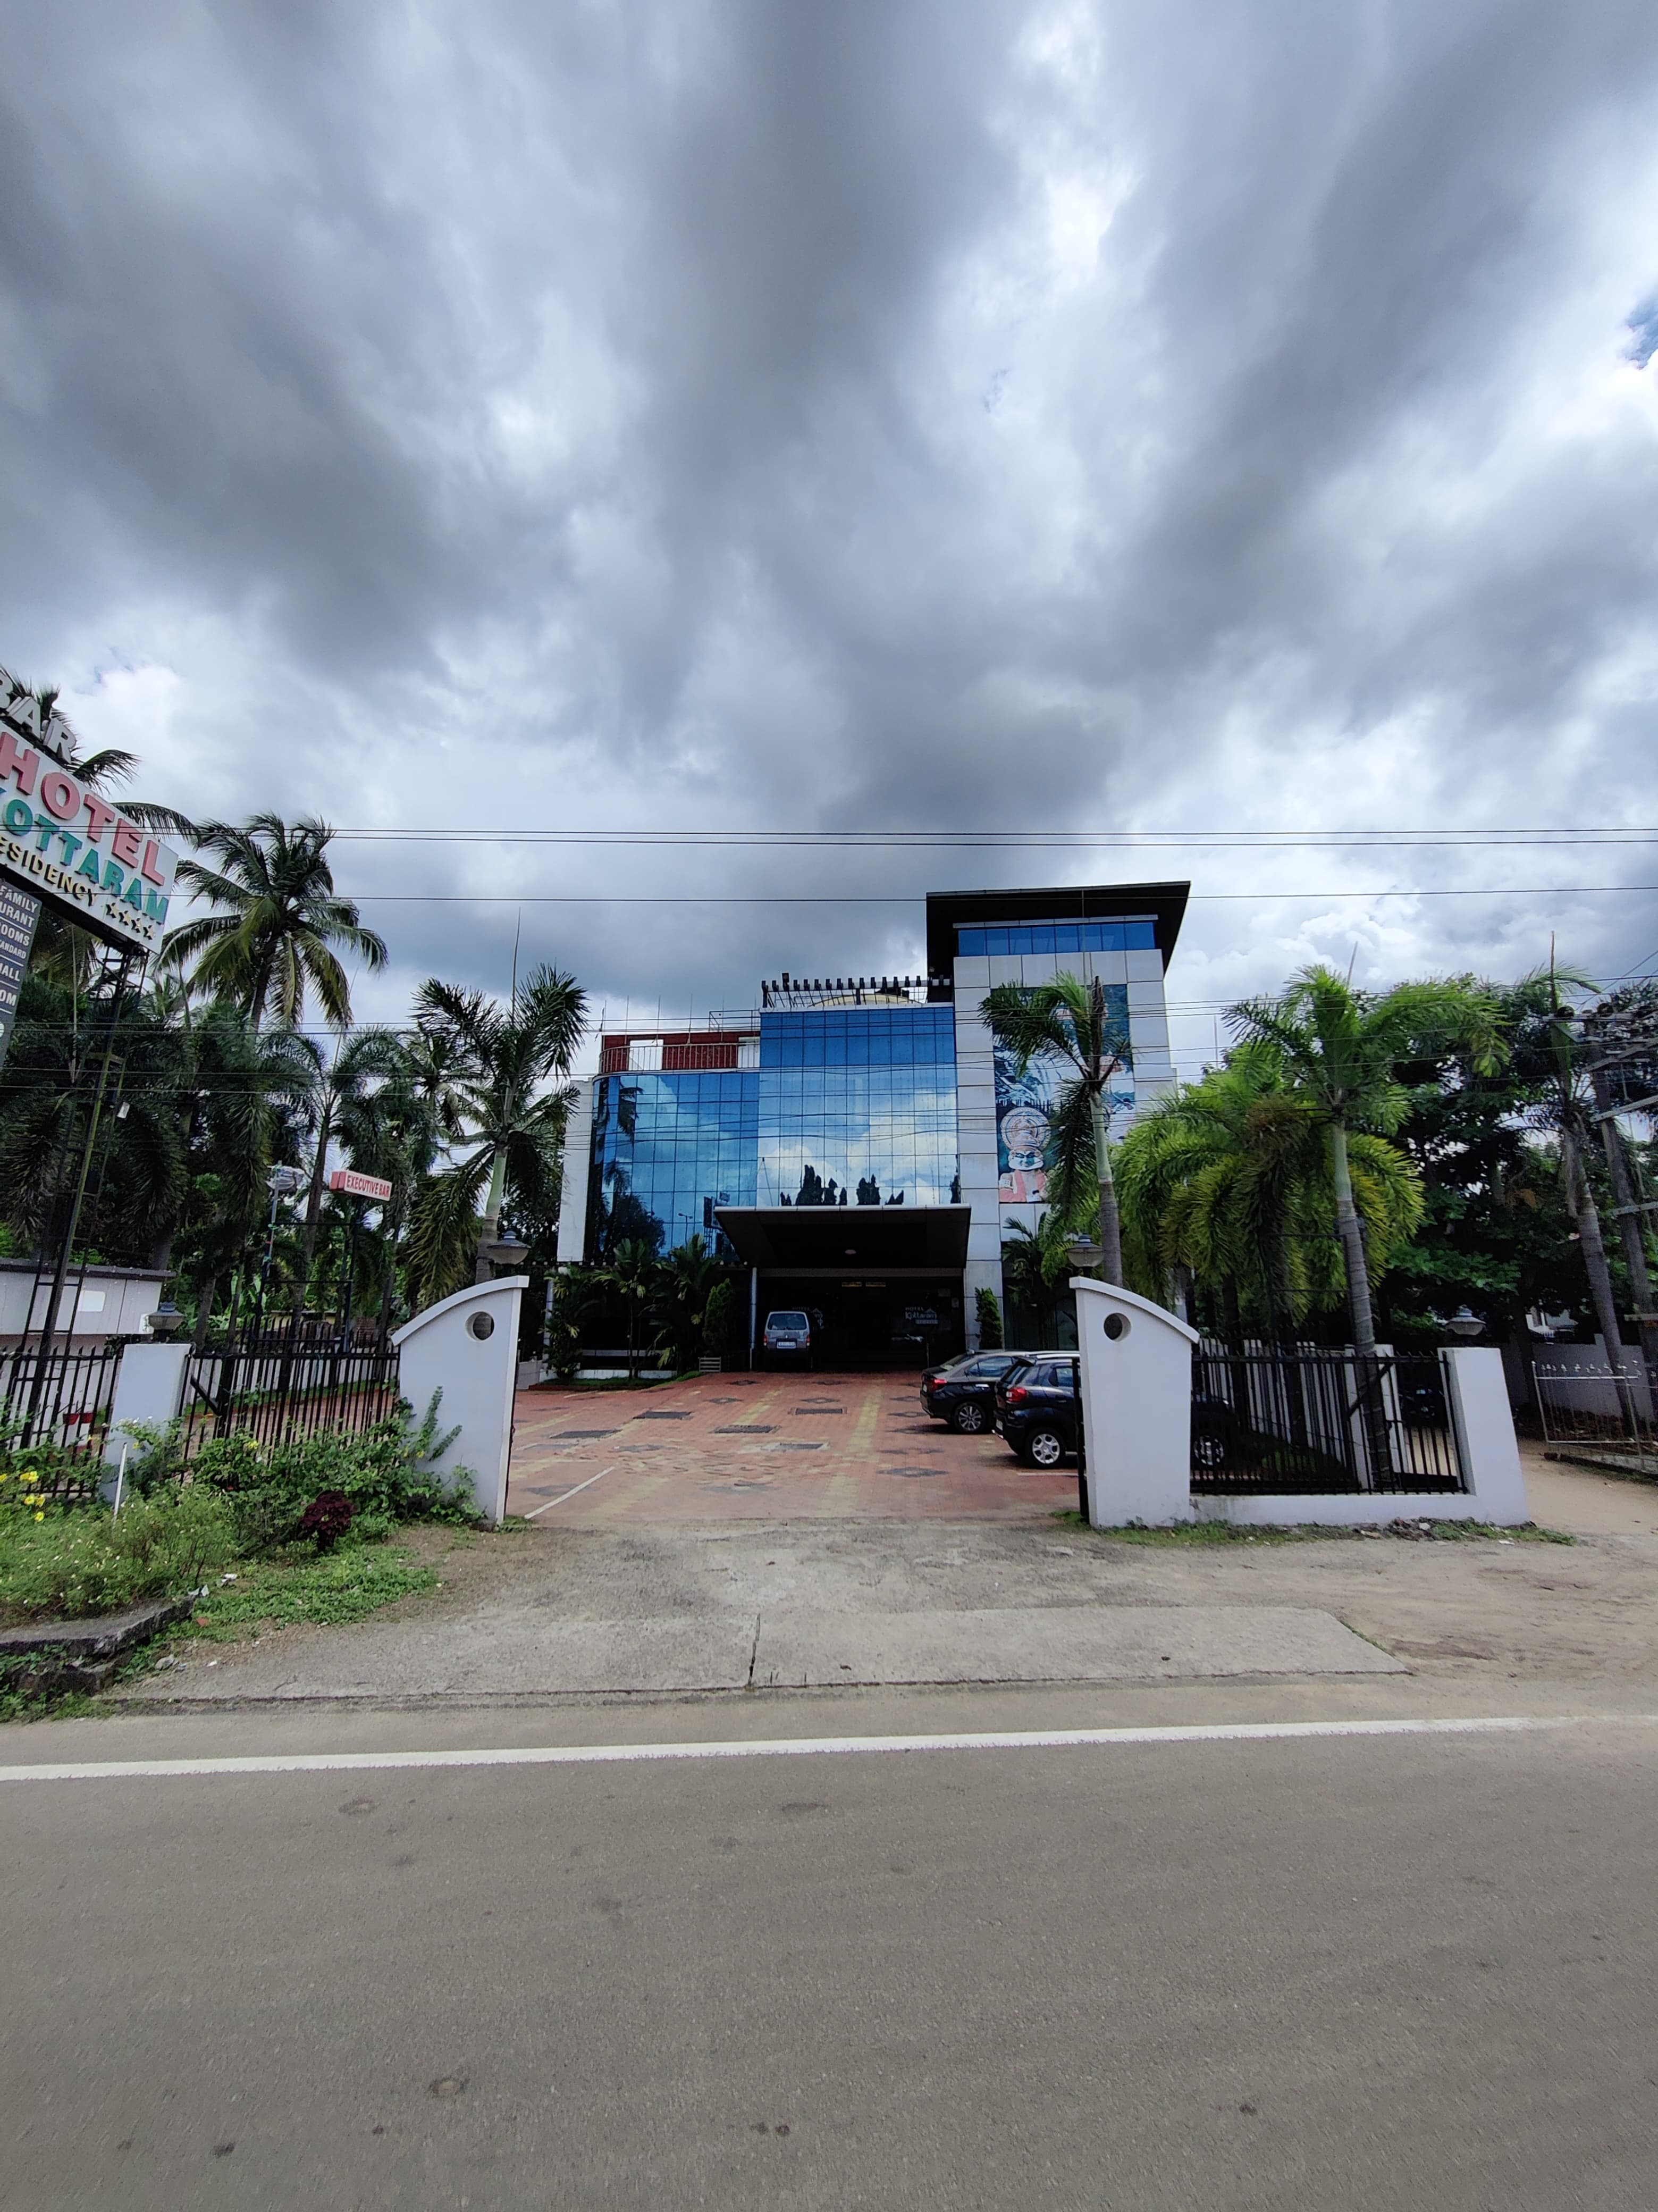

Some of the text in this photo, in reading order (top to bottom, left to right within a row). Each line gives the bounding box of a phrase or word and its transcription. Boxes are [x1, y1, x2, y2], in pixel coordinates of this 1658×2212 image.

[0, 732, 165, 886] HOTEL
[0, 787, 169, 925] OTTARAM
[0, 885, 38, 913] FAMILY
[0, 922, 30, 946] OOMS
[347, 1175, 390, 1197] EXECUTIVE BAR
